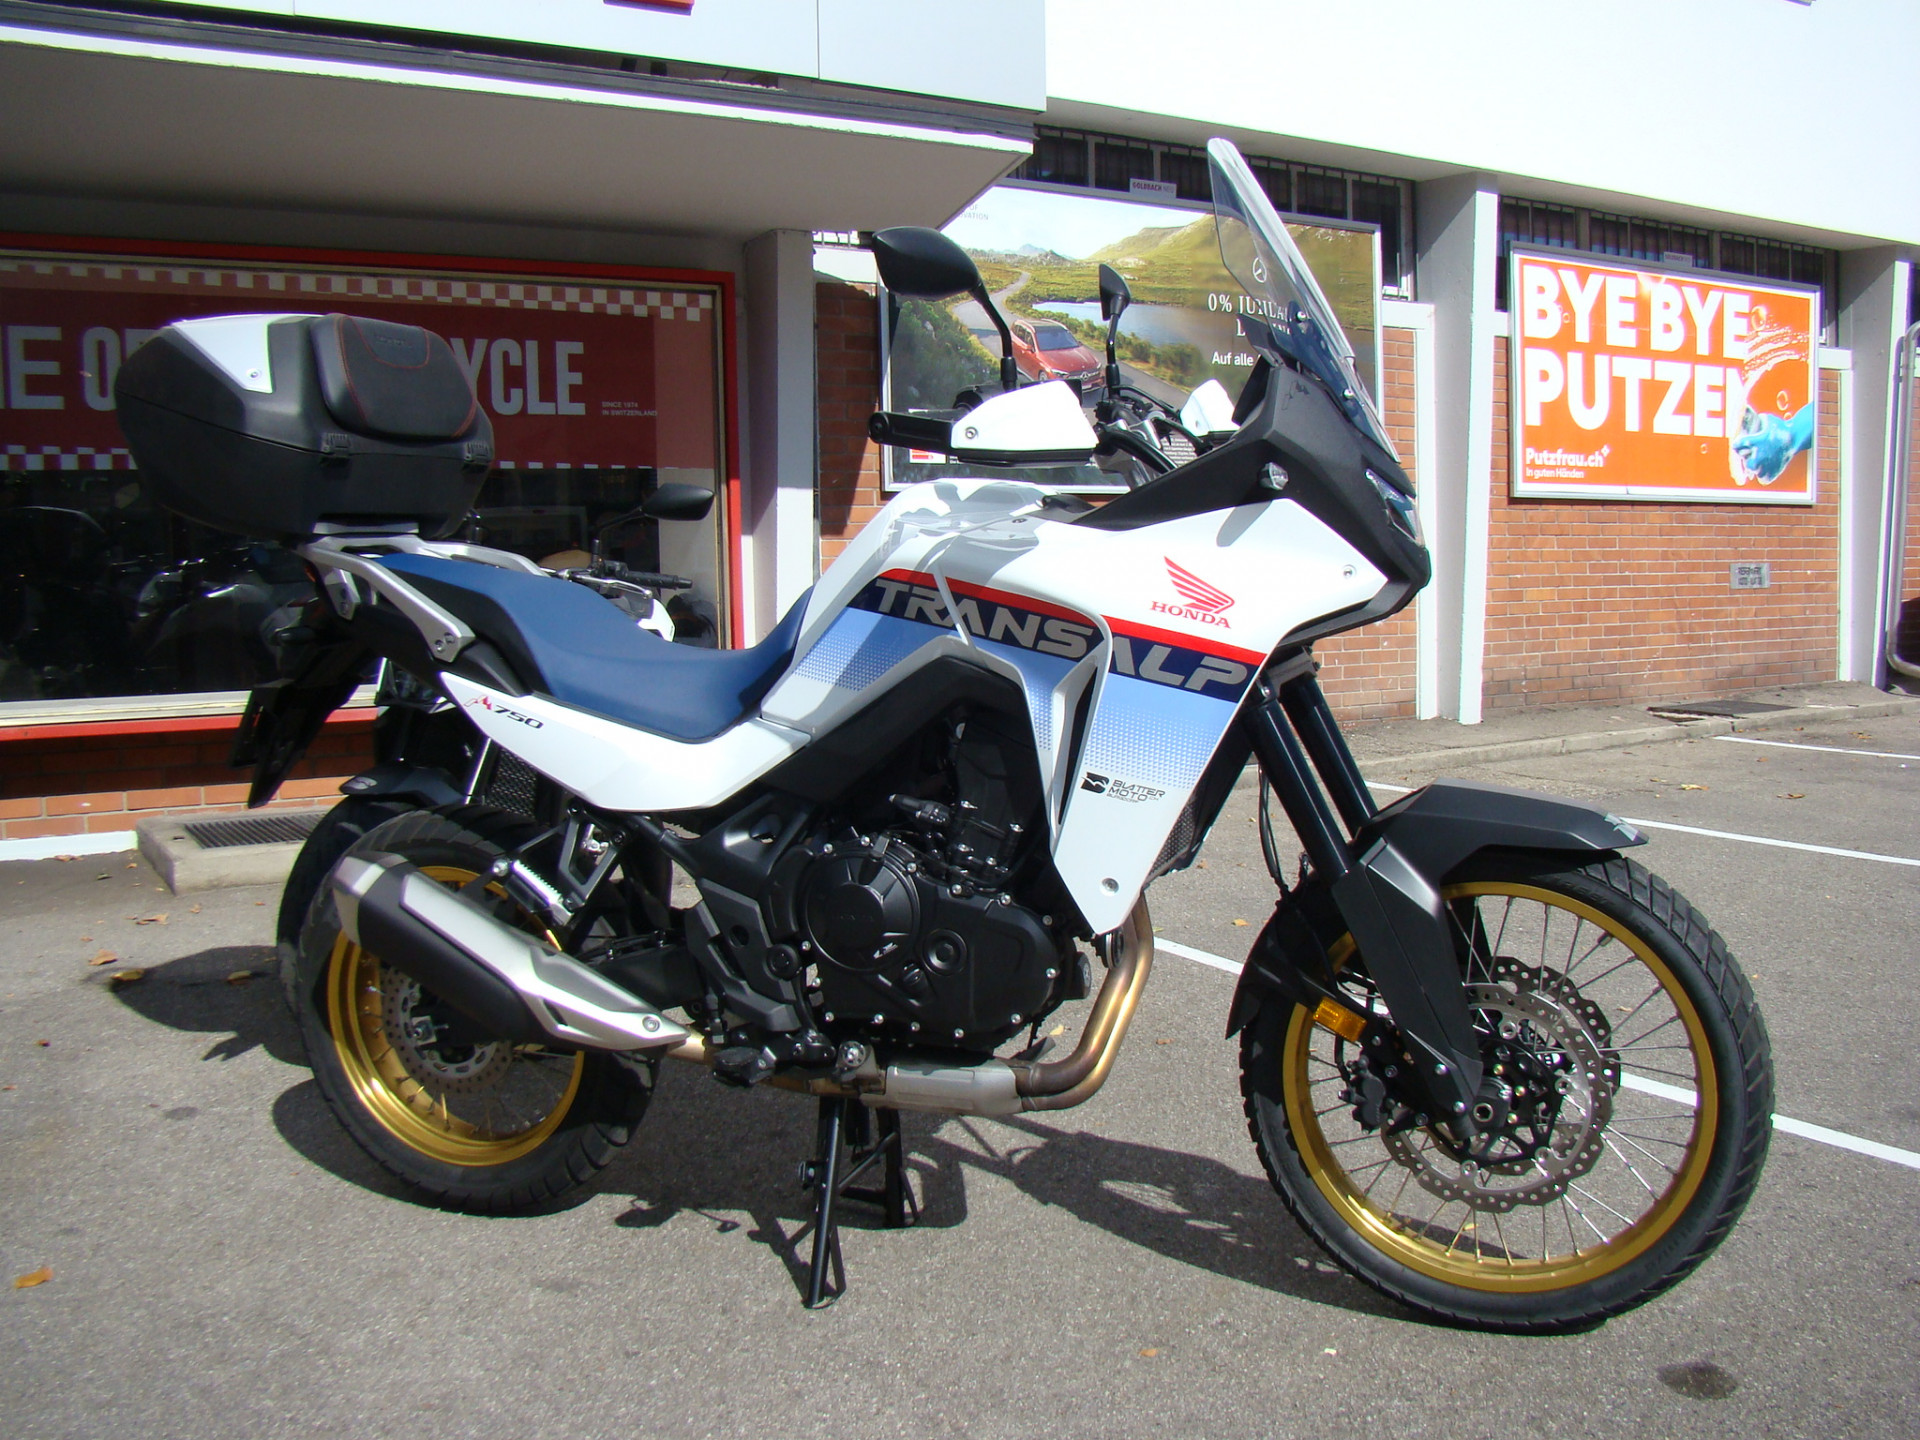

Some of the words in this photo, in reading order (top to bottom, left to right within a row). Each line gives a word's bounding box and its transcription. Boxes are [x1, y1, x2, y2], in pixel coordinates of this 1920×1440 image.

[1523, 264, 1637, 348] BYE
[1650, 280, 1752, 361] BYE
[0, 325, 65, 410] E
[1211, 351, 1231, 366] Auf
[1234, 352, 1254, 366] alle
[611, 409, 658, 417] SWITZERLAND
[1525, 447, 1604, 468] Putzfrau.ch
[1525, 467, 1534, 478] In
[1534, 468, 1555, 479] guten
[1556, 467, 1585, 479] Händen
[1149, 600, 1232, 629] HONDA
[874, 578, 1249, 692] TRANSALP
[494, 704, 545, 729] 750
[1108, 786, 1148, 802] MOTO
